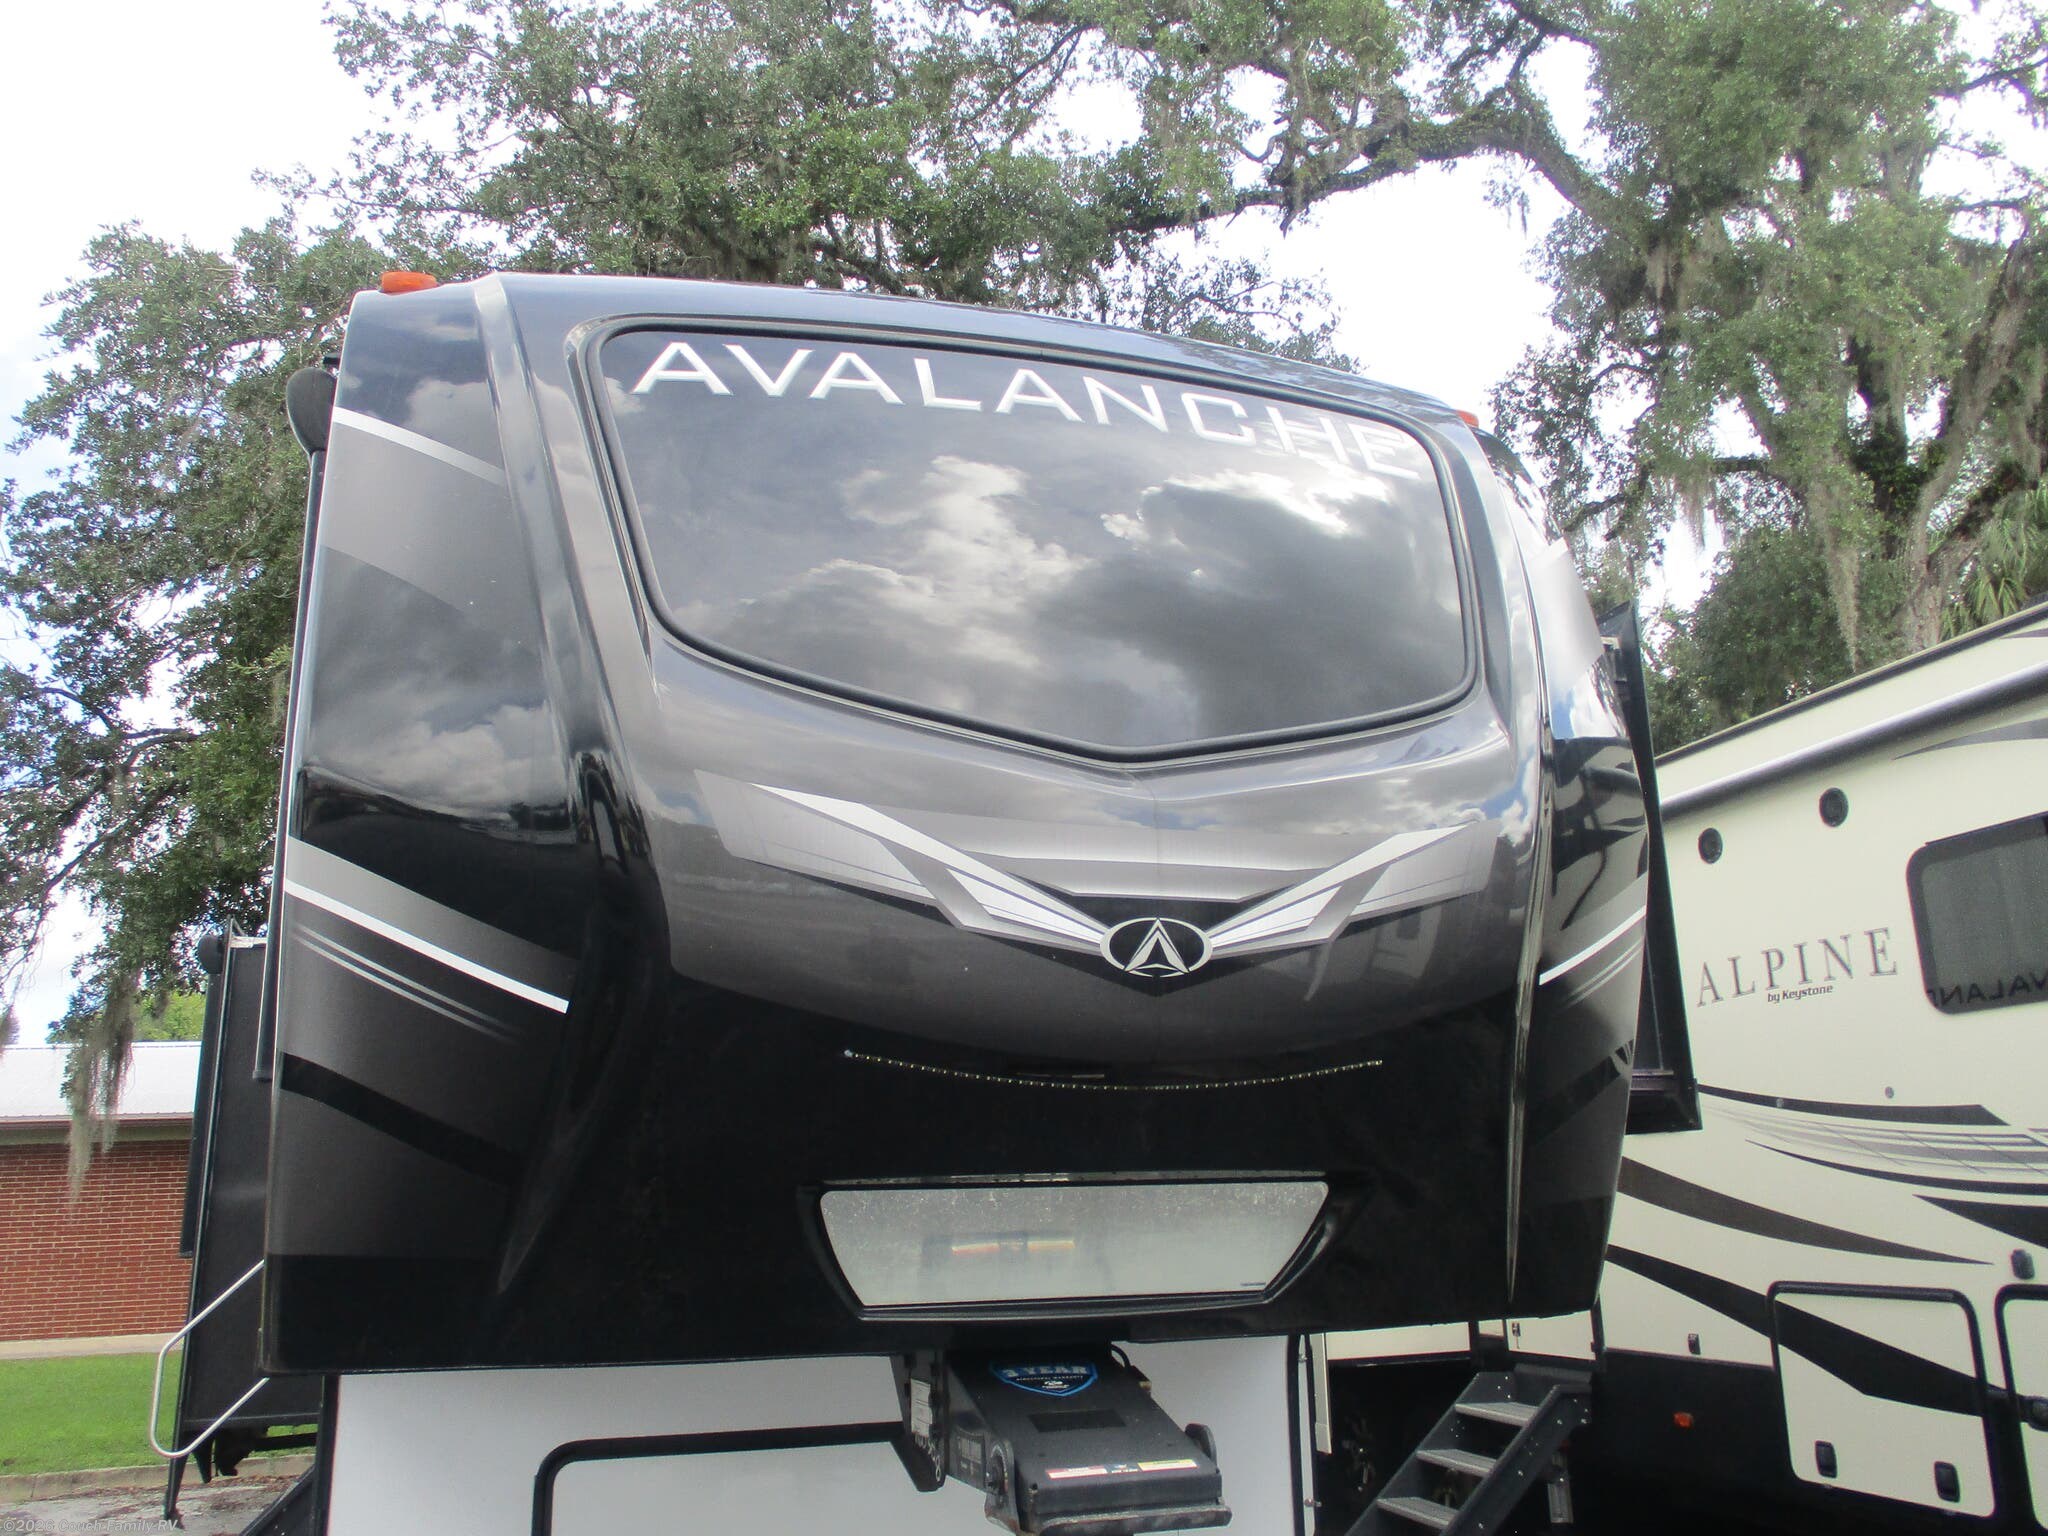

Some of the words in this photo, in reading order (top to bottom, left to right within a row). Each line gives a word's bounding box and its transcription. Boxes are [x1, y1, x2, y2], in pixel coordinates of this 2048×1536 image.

[632, 341, 1420, 480] AVALANCHE
[1697, 926, 1896, 1007] ALPINE
[1767, 993, 1780, 1004] by
[1782, 985, 1833, 1000] Keystone
